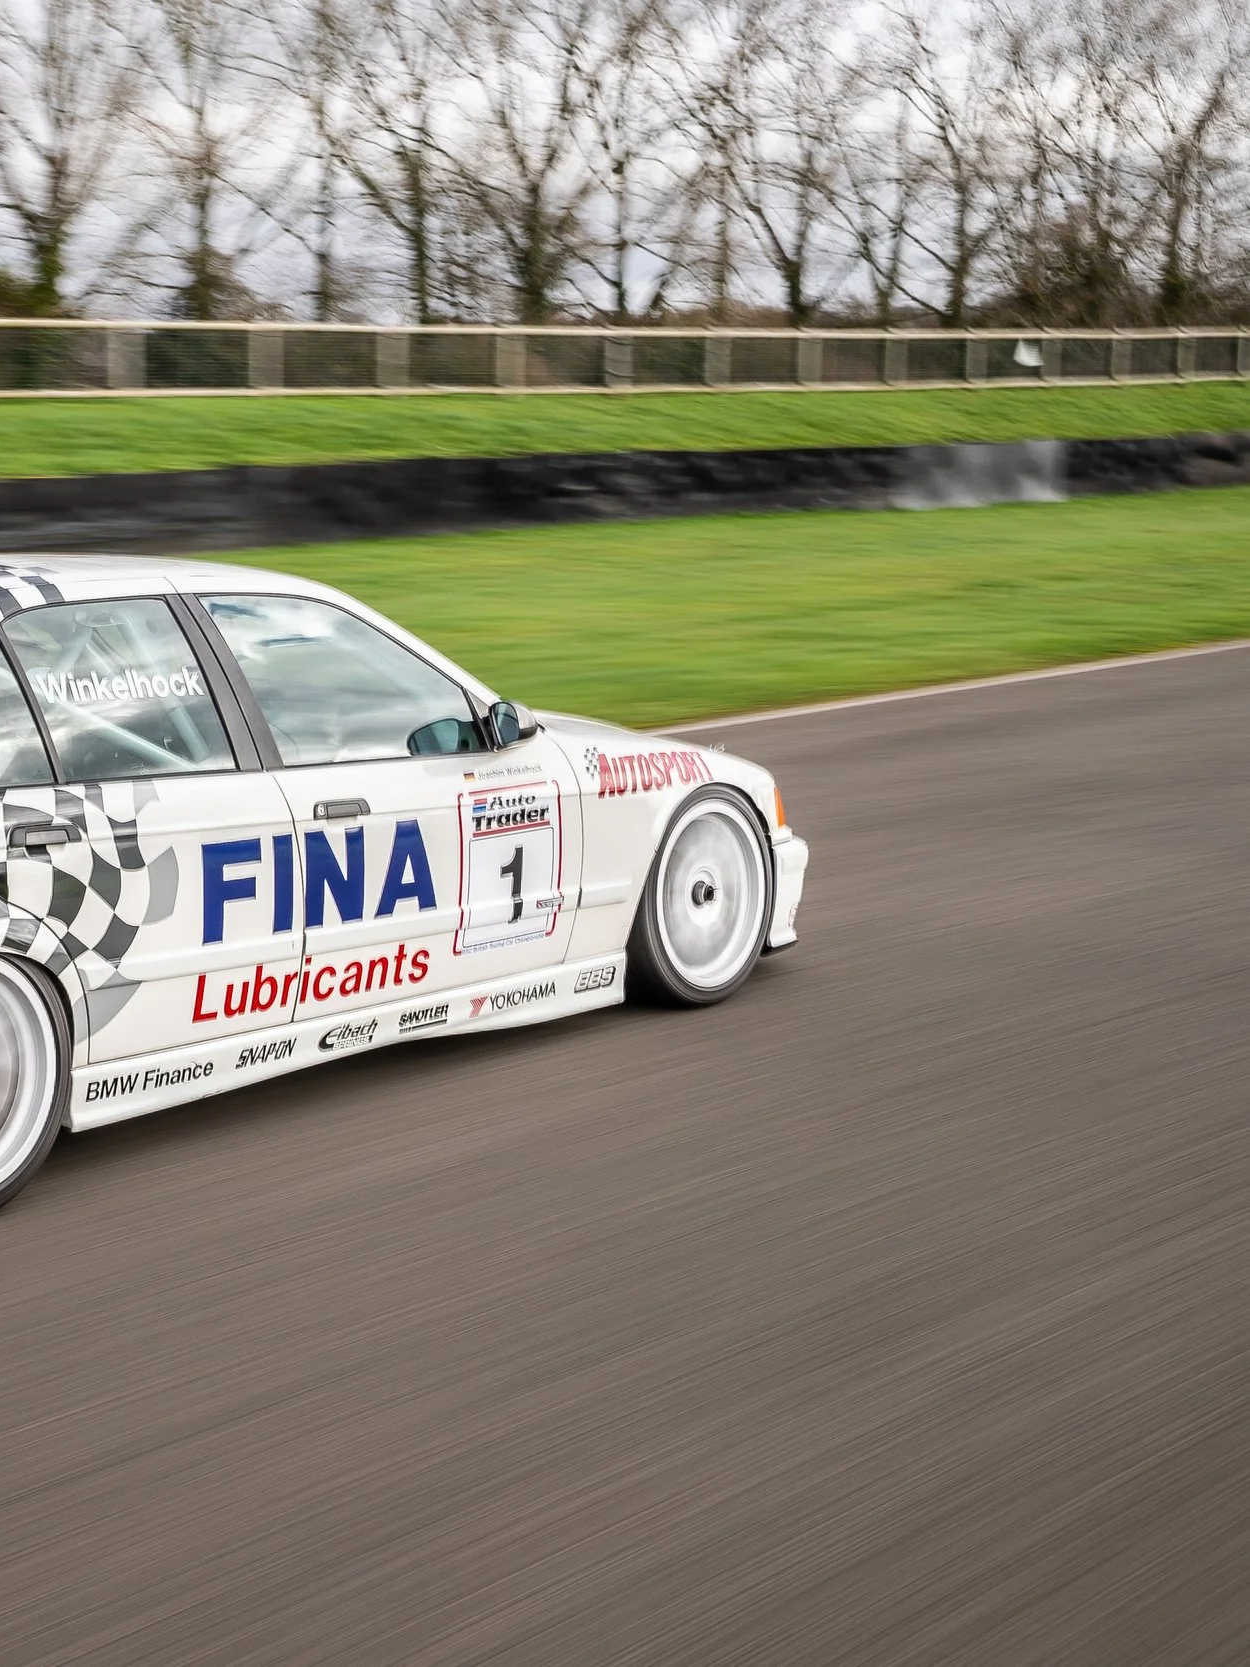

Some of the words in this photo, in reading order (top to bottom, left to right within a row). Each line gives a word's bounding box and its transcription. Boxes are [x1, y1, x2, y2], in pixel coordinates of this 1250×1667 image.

[35, 665, 206, 704] Winkelhock
[597, 751, 714, 799] AUTOSPORT
[472, 806, 550, 832] Trader
[488, 793, 536, 812] Auto
[201, 819, 438, 946] FINA
[500, 844, 524, 924] 1
[191, 942, 431, 1024] Lubricants
[488, 980, 557, 1011] YOKOHAMA
[574, 966, 616, 995] BBS
[85, 1073, 138, 1103] BMW
[142, 1060, 215, 1092] Finance
